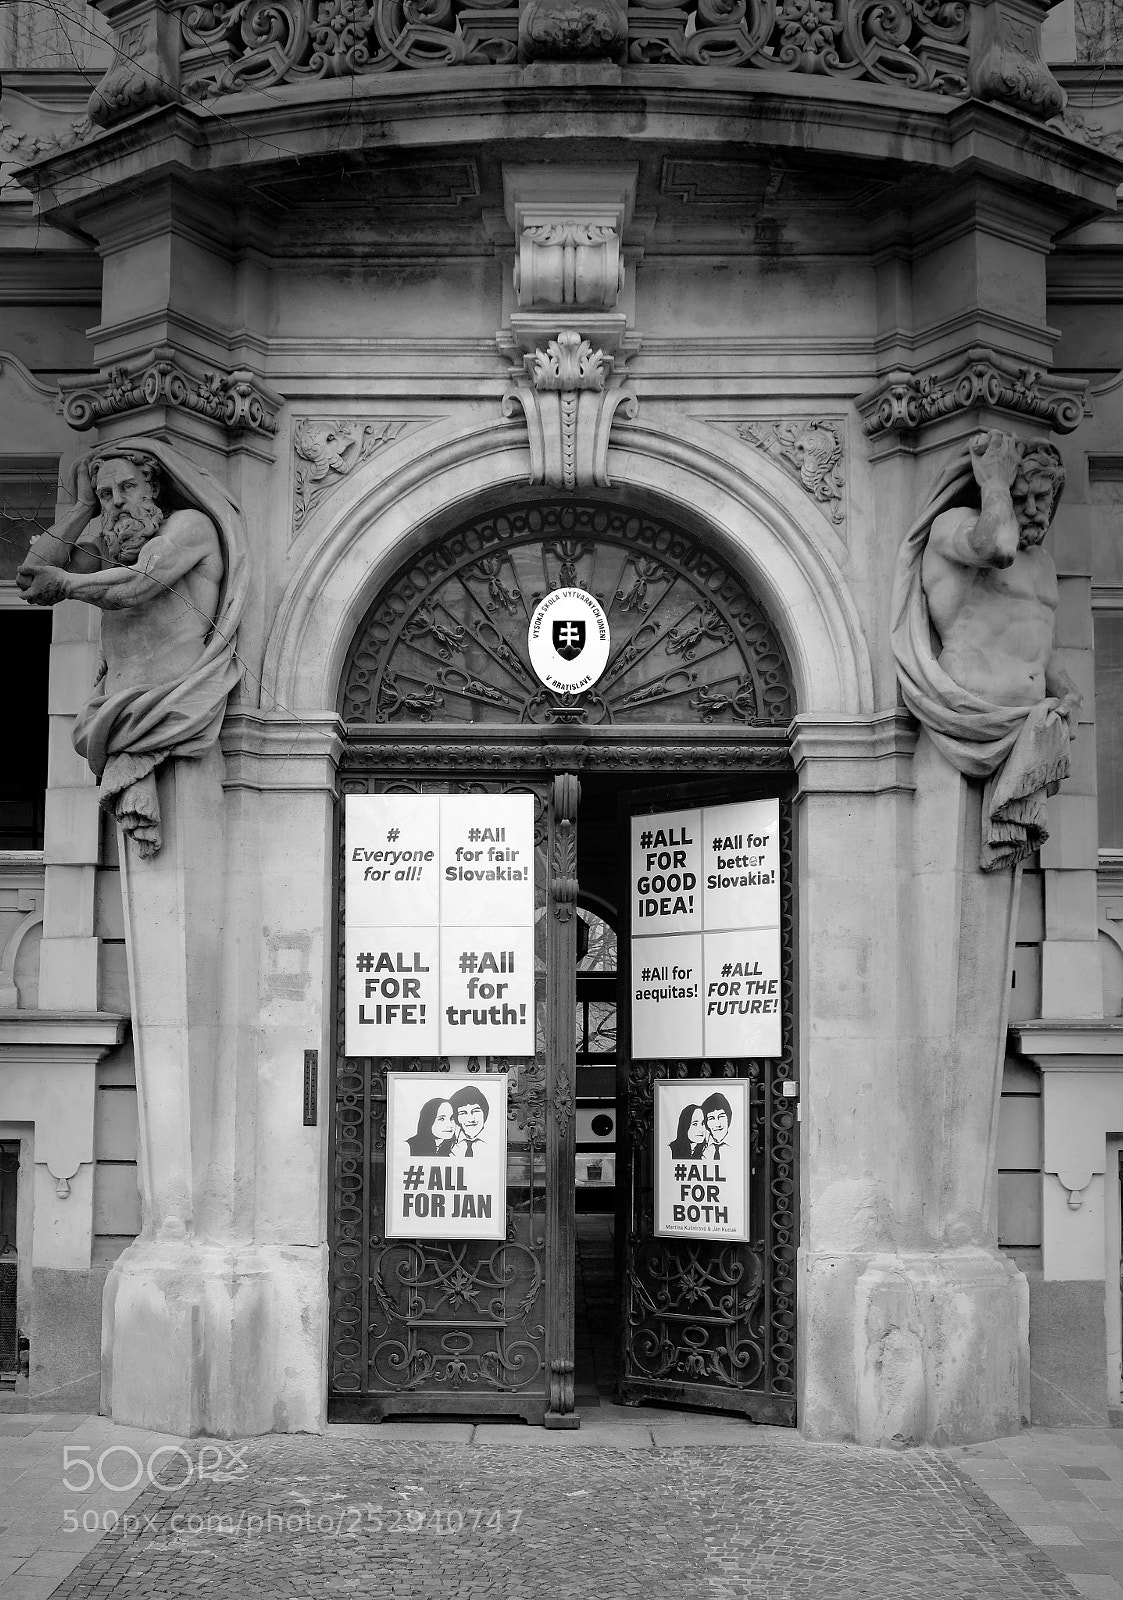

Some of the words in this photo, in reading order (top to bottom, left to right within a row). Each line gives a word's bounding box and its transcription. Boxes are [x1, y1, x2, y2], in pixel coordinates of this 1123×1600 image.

[552, 674, 592, 690] BRATISLAVE
[387, 828, 400, 842] #
[468, 827, 506, 842] #All
[640, 827, 693, 849] #ALL
[712, 835, 742, 851] #All
[747, 834, 769, 848] for
[351, 847, 434, 865] Everyone
[455, 847, 483, 862] for
[487, 847, 519, 862] fair
[646, 851, 686, 871] FOR
[717, 854, 765, 870] better
[363, 866, 390, 881] for
[394, 866, 423, 881] all!
[445, 866, 529, 881] Slovakia!
[707, 870, 775, 889] Slovakia!
[638, 873, 696, 895] GOOD
[638, 896, 694, 917] IDEA!
[356, 952, 430, 973] #ALL
[458, 951, 515, 974] #All
[721, 962, 762, 977] #ALL
[641, 967, 668, 981] #All
[673, 966, 692, 980] for
[365, 978, 421, 998] FOR
[467, 977, 508, 999] for
[636, 984, 698, 1002] aequitas!
[708, 981, 741, 997] FOR
[745, 980, 778, 994] THE
[358, 1004, 426, 1025] LIFE!
[446, 1004, 526, 1025] truth!
[707, 999, 778, 1016] FUTURE!
[403, 1165, 468, 1191] #ALL
[674, 1164, 726, 1182] #ALL
[681, 1185, 720, 1203] FOR
[402, 1193, 445, 1218] FOR
[452, 1194, 492, 1218] JAN
[673, 1205, 728, 1223] BOTH
